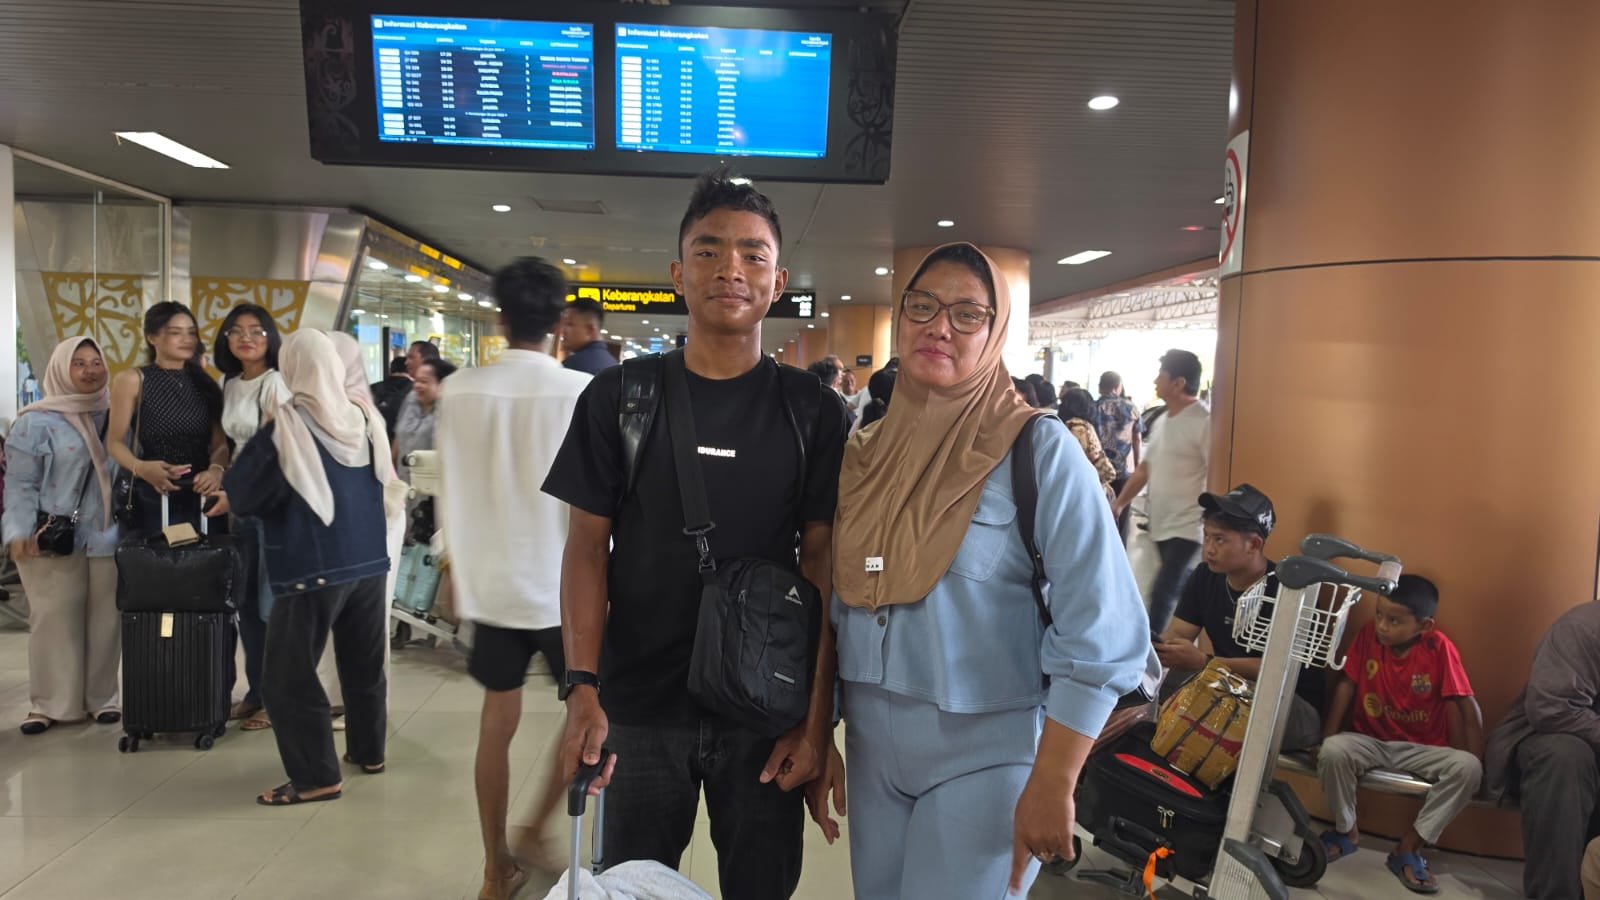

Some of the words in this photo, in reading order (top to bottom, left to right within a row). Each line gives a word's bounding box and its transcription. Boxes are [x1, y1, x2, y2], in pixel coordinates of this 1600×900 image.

[383, 20, 416, 29] Informasi
[415, 21, 468, 31] Keberangkatan
[627, 27, 659, 37] Informasi
[659, 29, 710, 40] Keberangkatan
[602, 288, 676, 305] Keberangkatan
[602, 301, 637, 312] Departures
[1366, 659, 1379, 681] 9
